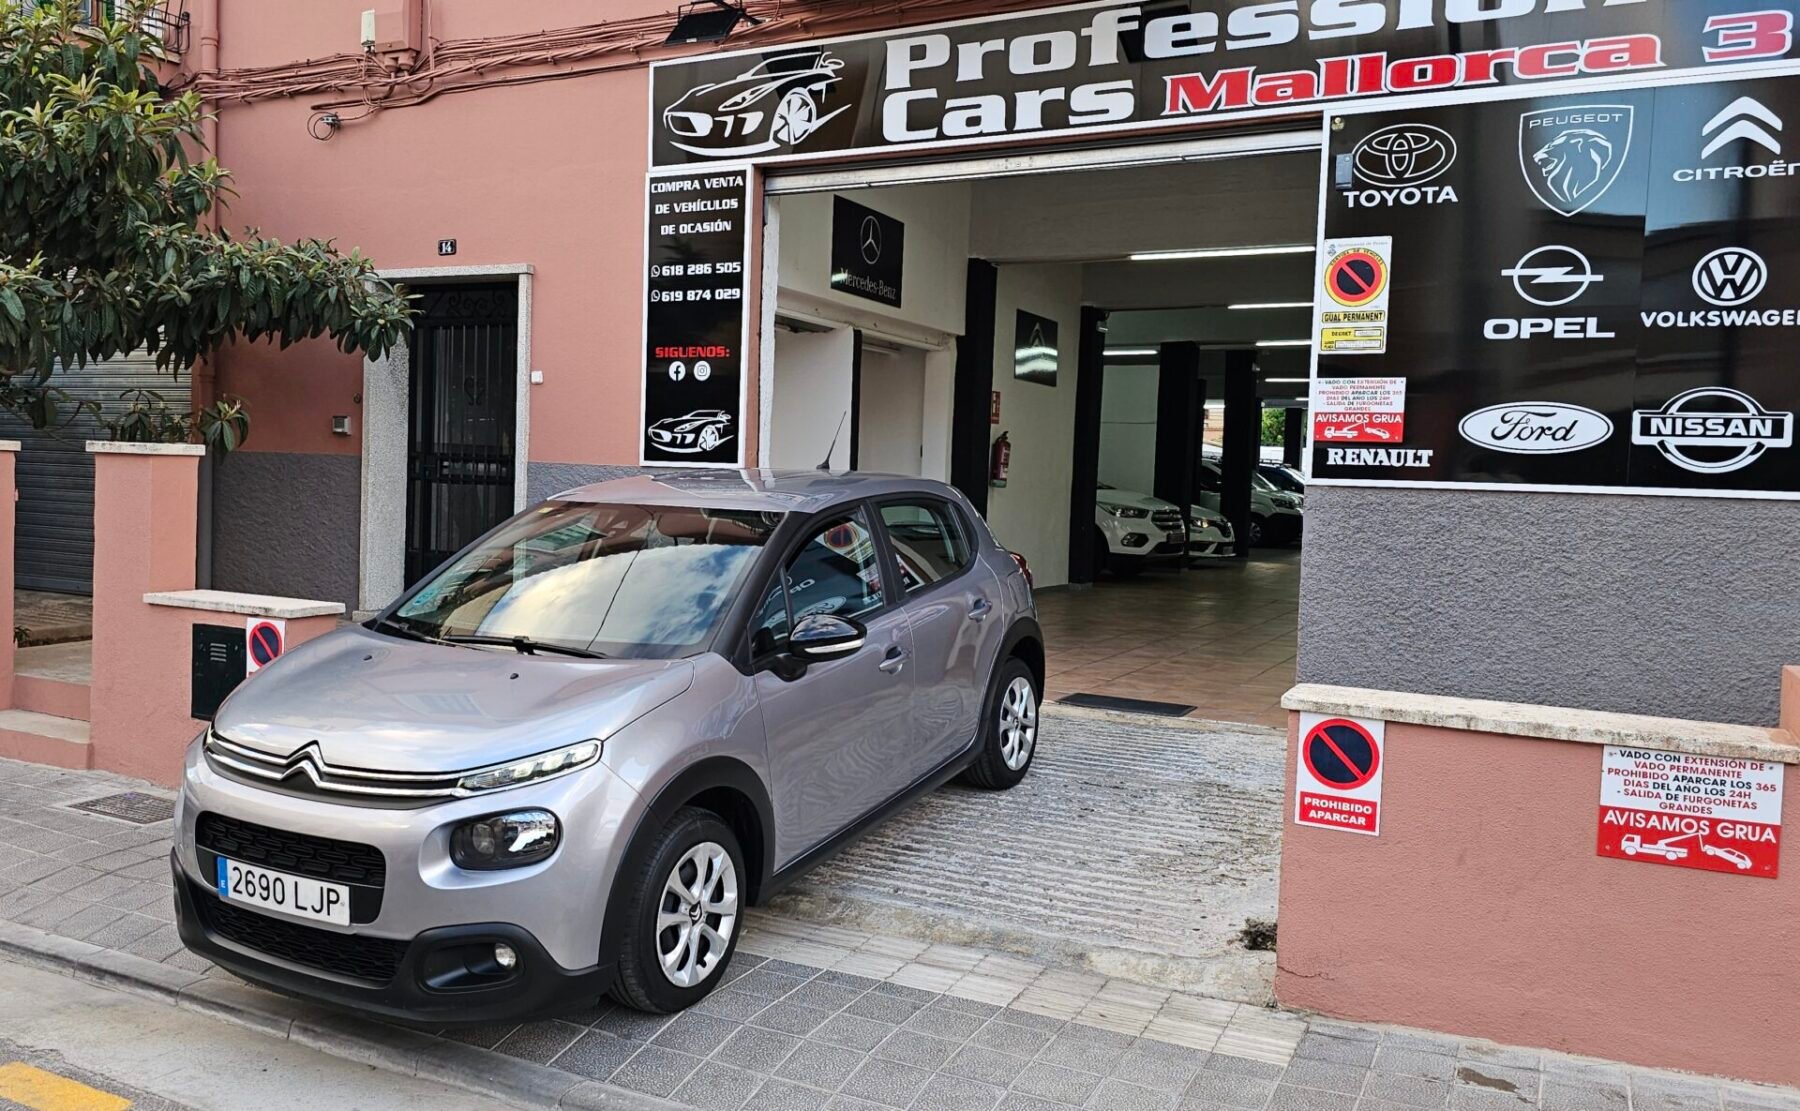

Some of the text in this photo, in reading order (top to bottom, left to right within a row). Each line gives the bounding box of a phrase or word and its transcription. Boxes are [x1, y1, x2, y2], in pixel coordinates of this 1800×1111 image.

[883, 10, 1792, 142] Cars Mallorca 3
[1529, 113, 1623, 128] PEUGEOT
[651, 176, 743, 193] COMPRA VENTA
[655, 198, 738, 214] DE VEHÍCULOS
[1343, 186, 1458, 208] TOYOTA
[661, 219, 731, 235] DE OCASIÓN
[662, 262, 741, 276] 618 286 505
[662, 288, 740, 302] 619 874 029
[1324, 312, 1383, 322] GUAL PERMANENT
[1641, 309, 1800, 328] VOLKSWAGE
[1484, 317, 1615, 339] OPEL
[655, 346, 730, 358] SIGUENOS:
[1316, 414, 1402, 423] AVISAMOS GRUA
[1490, 410, 1579, 443] Ford
[1650, 417, 1772, 437] NISSAN
[1326, 448, 1433, 467] RENAULT
[1619, 750, 1765, 771] VADO CON EXTENSIÓN DE
[1634, 761, 1743, 779] VADO PERMANENTE
[1607, 768, 1776, 792] PROHIBIDO APARCAR LOS 365
[1623, 779, 1751, 799] DIAS DEL AÑO LOS 24H
[1304, 796, 1372, 815] PROHIBIDO
[1624, 788, 1757, 810] SALIDA DE FURGONETAS
[1659, 802, 1713, 815] GRANDES
[1308, 810, 1366, 826] APARCAR
[1603, 809, 1776, 844] AVISAMOS GRUA
[232, 866, 340, 916] 2690 LJP
